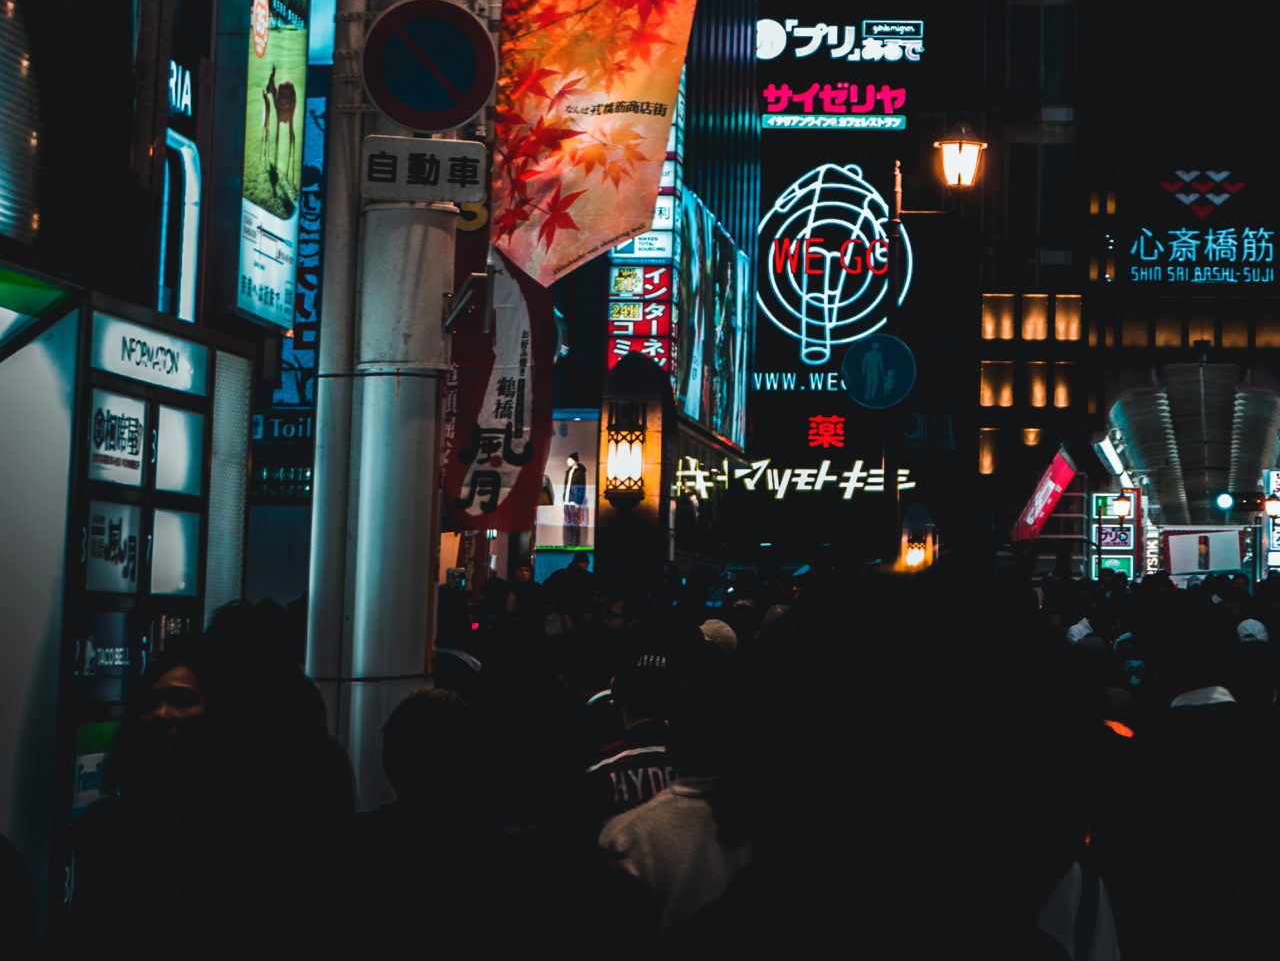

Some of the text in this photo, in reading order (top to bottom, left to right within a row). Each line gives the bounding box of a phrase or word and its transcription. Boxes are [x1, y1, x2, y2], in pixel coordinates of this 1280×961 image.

[763, 82, 907, 115] サイゼリヤ
[367, 151, 480, 189] 自動車
[1130, 227, 1276, 263] 心斎橋筋
[1130, 266, 1162, 282] SHIN
[611, 303, 640, 319] 24H
[808, 414, 846, 449] 薬
